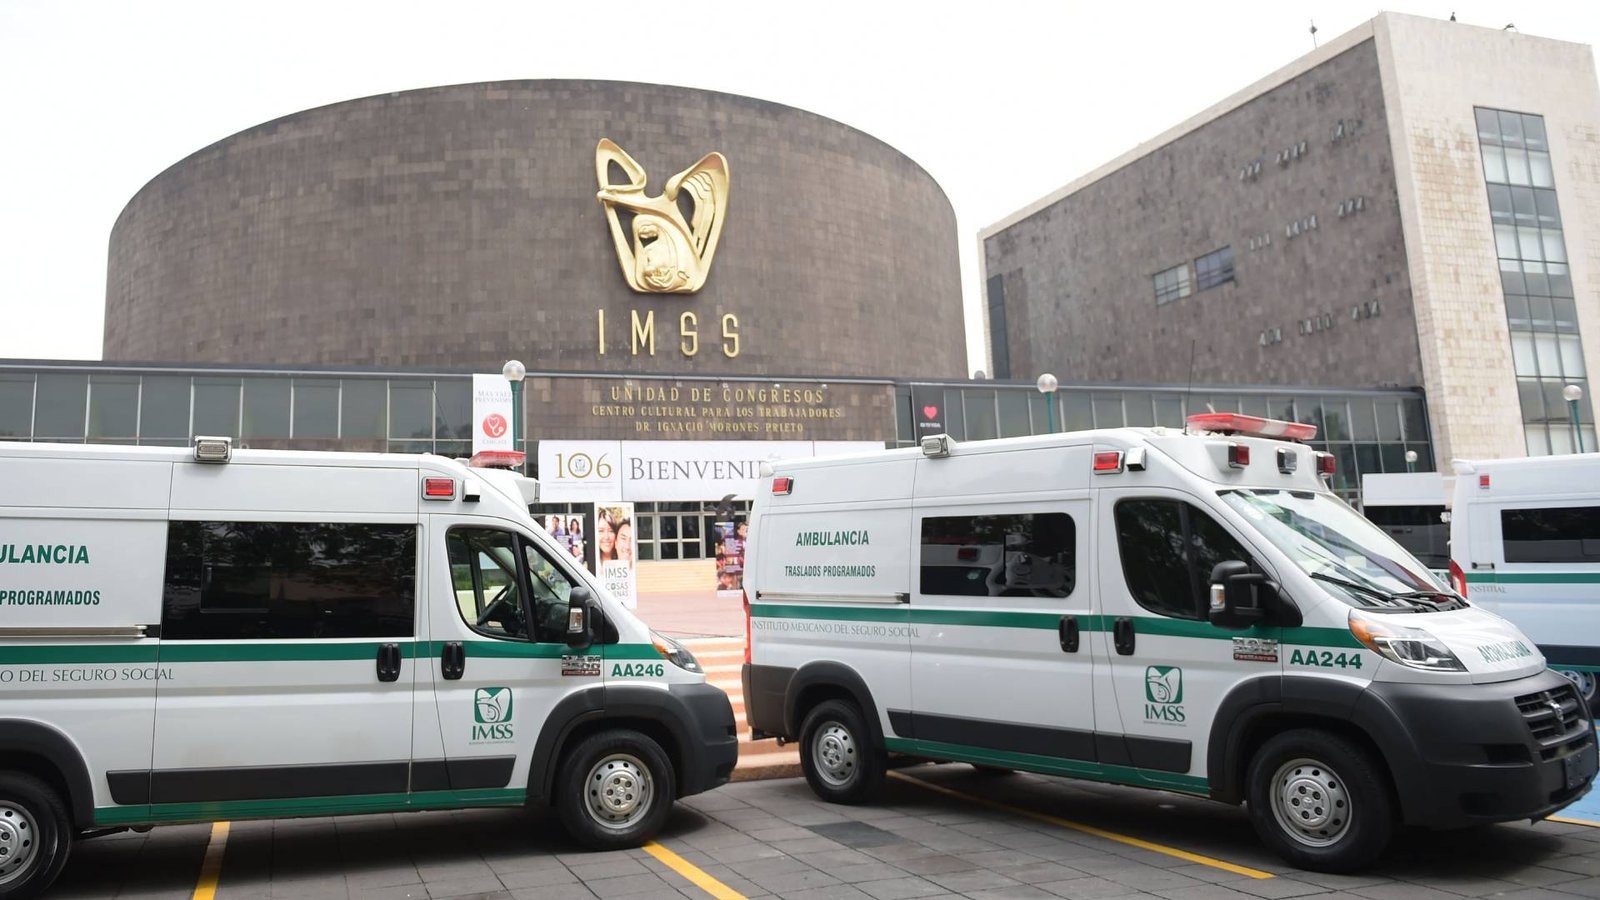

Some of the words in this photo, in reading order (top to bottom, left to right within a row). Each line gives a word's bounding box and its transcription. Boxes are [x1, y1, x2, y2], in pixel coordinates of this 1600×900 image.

[598, 309, 740, 358] IMSS
[611, 386, 680, 401] UNIDAD
[691, 387, 712, 402] DE
[722, 388, 824, 403] CONGRESOS
[592, 406, 635, 416] CENTRO
[641, 406, 697, 417] CULTURAL
[702, 407, 731, 417] PARA
[736, 407, 754, 417] LOS
[759, 407, 841, 418] TRABAJADORES
[658, 421, 702, 432] IGNACIO
[709, 422, 759, 432] MORONES
[765, 423, 804, 433] PRIETO
[555, 452, 612, 479] 106
[795, 530, 870, 547] AMBULANCIA
[604, 567, 629, 579] IMSS
[784, 565, 821, 578] TRASLADOS
[823, 565, 876, 578] PROGRAMADOS
[0, 590, 101, 605] PROGRAMADOS
[752, 620, 789, 631] INSTITUTO
[791, 622, 833, 634] MEXICANO
[834, 623, 850, 635] DEL
[851, 624, 886, 637] SEGURO
[888, 626, 920, 638] SOCIAL
[1290, 649, 1363, 669] AA244
[19, 669, 48, 682] DEL
[52, 668, 117, 682] SEGURO
[121, 668, 175, 681] SOCIAL
[611, 663, 664, 677] AA246
[1144, 703, 1186, 723] IMSS
[472, 724, 514, 740] IMSS
